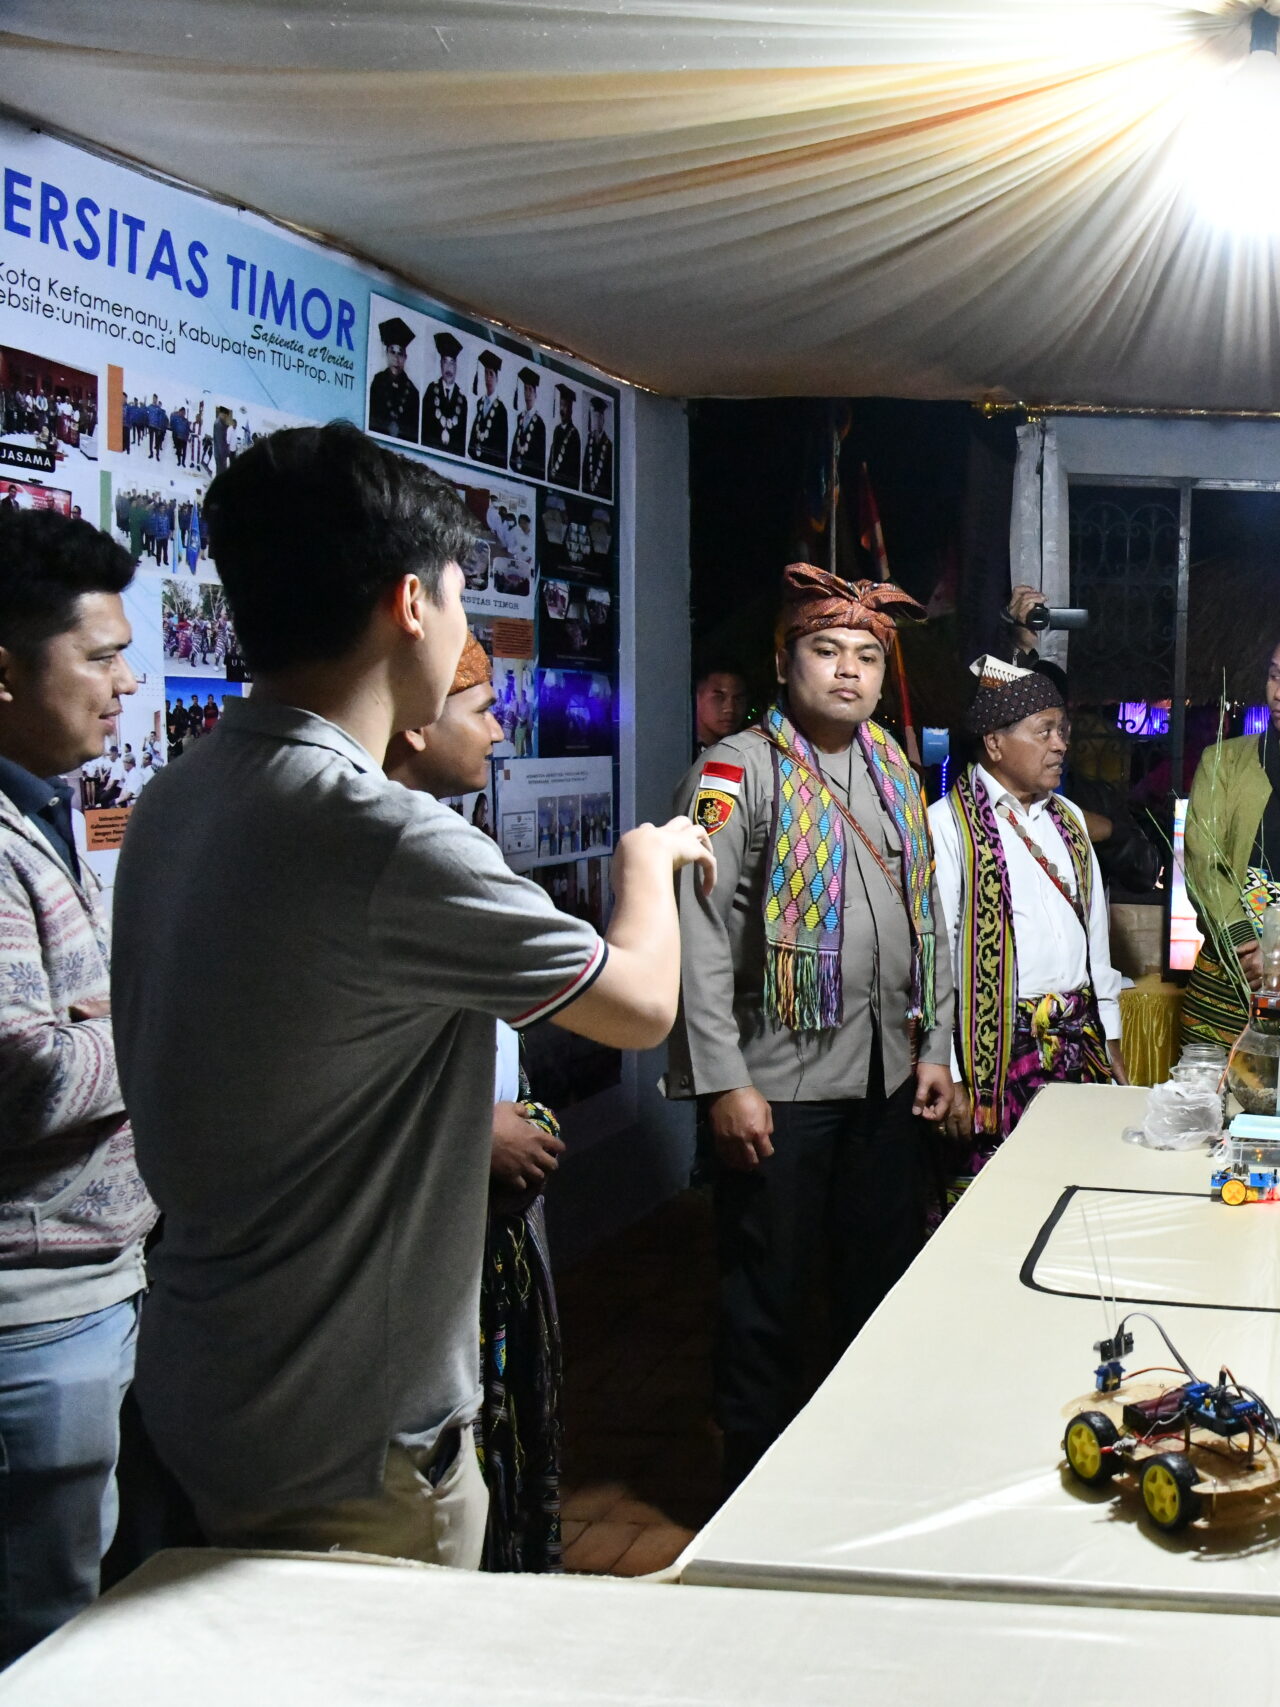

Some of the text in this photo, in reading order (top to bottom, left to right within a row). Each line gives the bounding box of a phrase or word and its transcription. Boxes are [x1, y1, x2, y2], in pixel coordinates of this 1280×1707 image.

[4, 167, 355, 351] ERSITAS TIMOR
[48, 277, 173, 335] Kefamenanu,
[179, 319, 265, 363] Kabupaten
[271, 350, 330, 389] TTU-Prop.
[335, 371, 355, 391] NTT
[251, 324, 354, 371] Sapientia et Veritas
[1, 448, 52, 467] JASAMA
